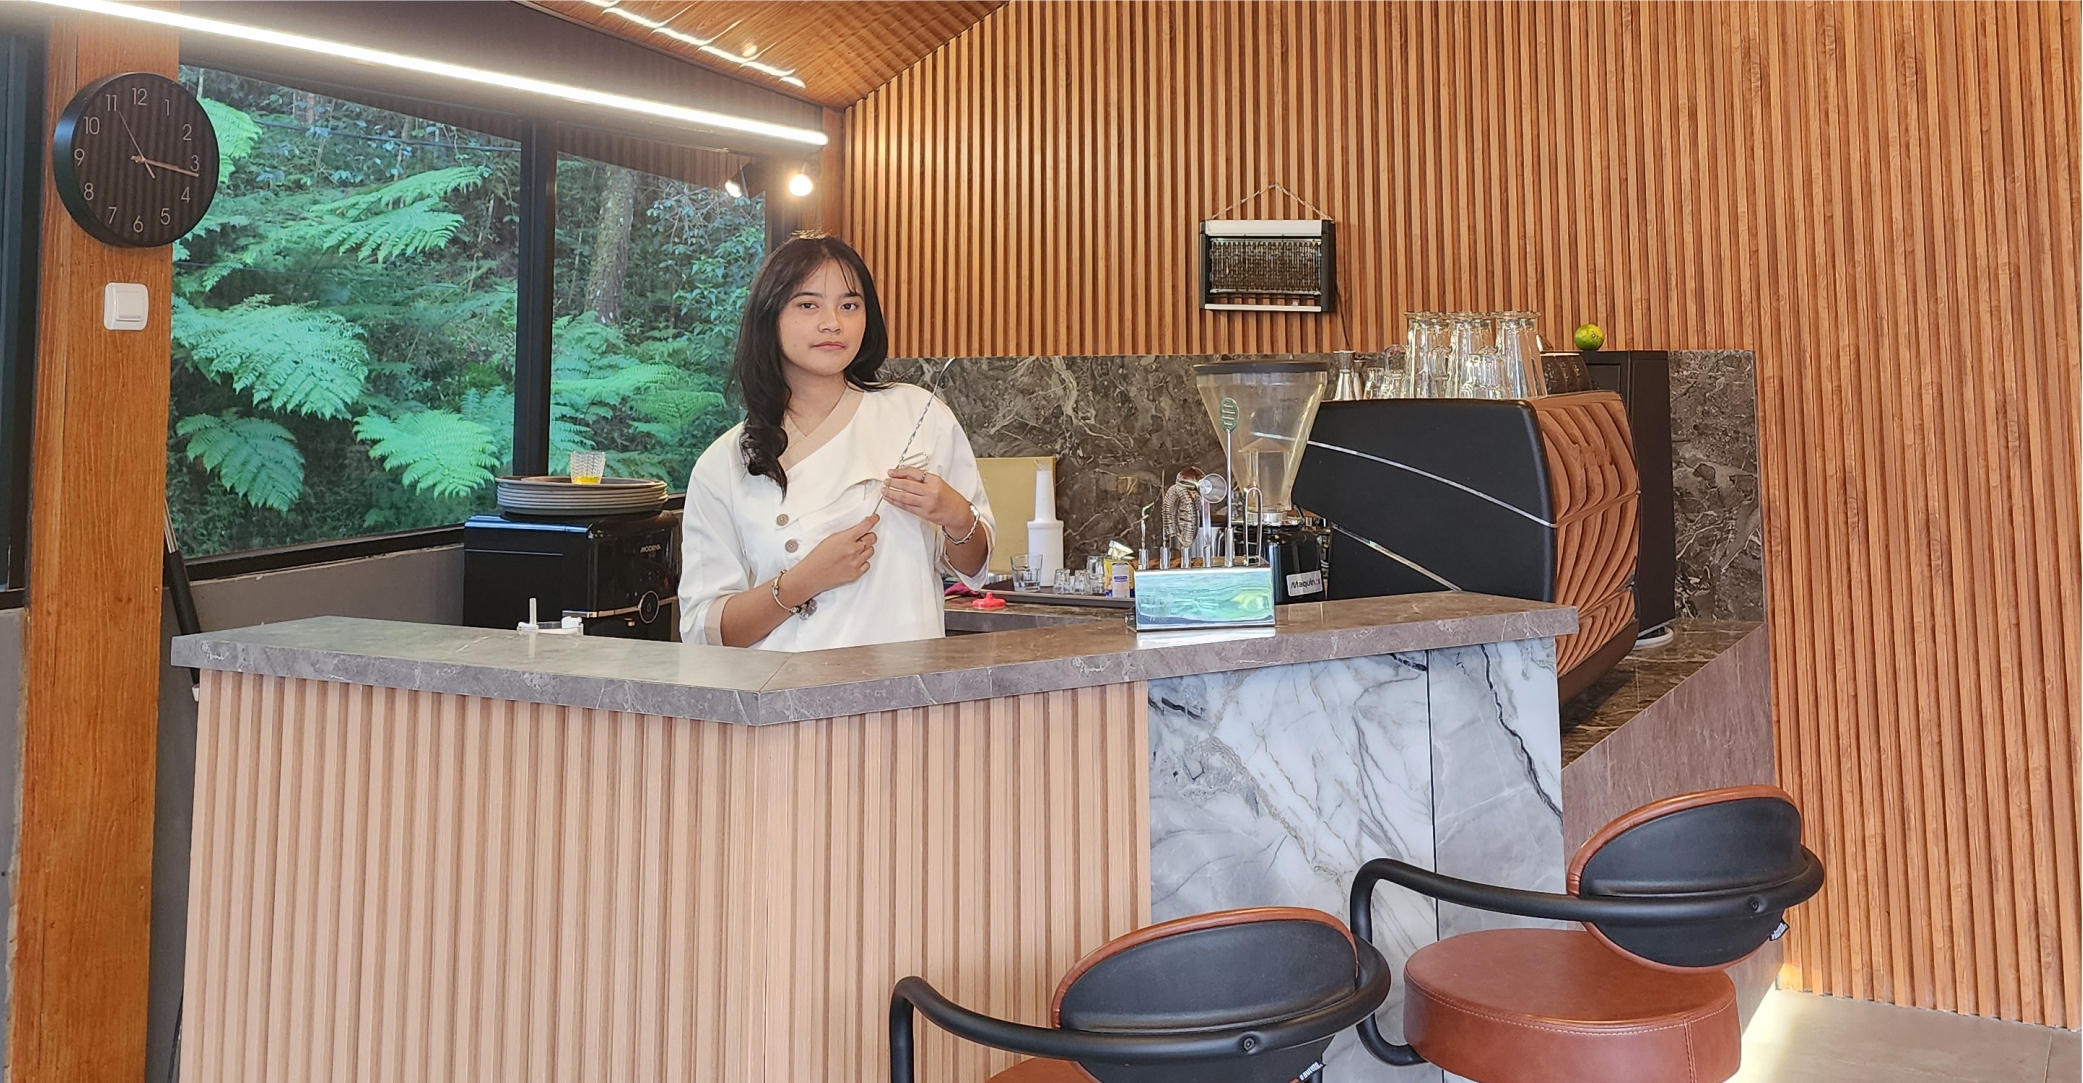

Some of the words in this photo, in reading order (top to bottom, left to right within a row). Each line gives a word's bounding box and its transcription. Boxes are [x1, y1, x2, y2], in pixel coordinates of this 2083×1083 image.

[105, 94, 118, 112] 11
[131, 87, 148, 106] 12
[164, 99, 170, 116] 1
[83, 116, 100, 135] 10
[182, 123, 192, 141] 2
[73, 148, 85, 166] 9
[190, 154, 200, 172] 3
[83, 182, 95, 201] 8
[180, 186, 191, 203] 4
[108, 206, 118, 224] 7
[132, 215, 144, 233] 6
[160, 207, 171, 225] 5
